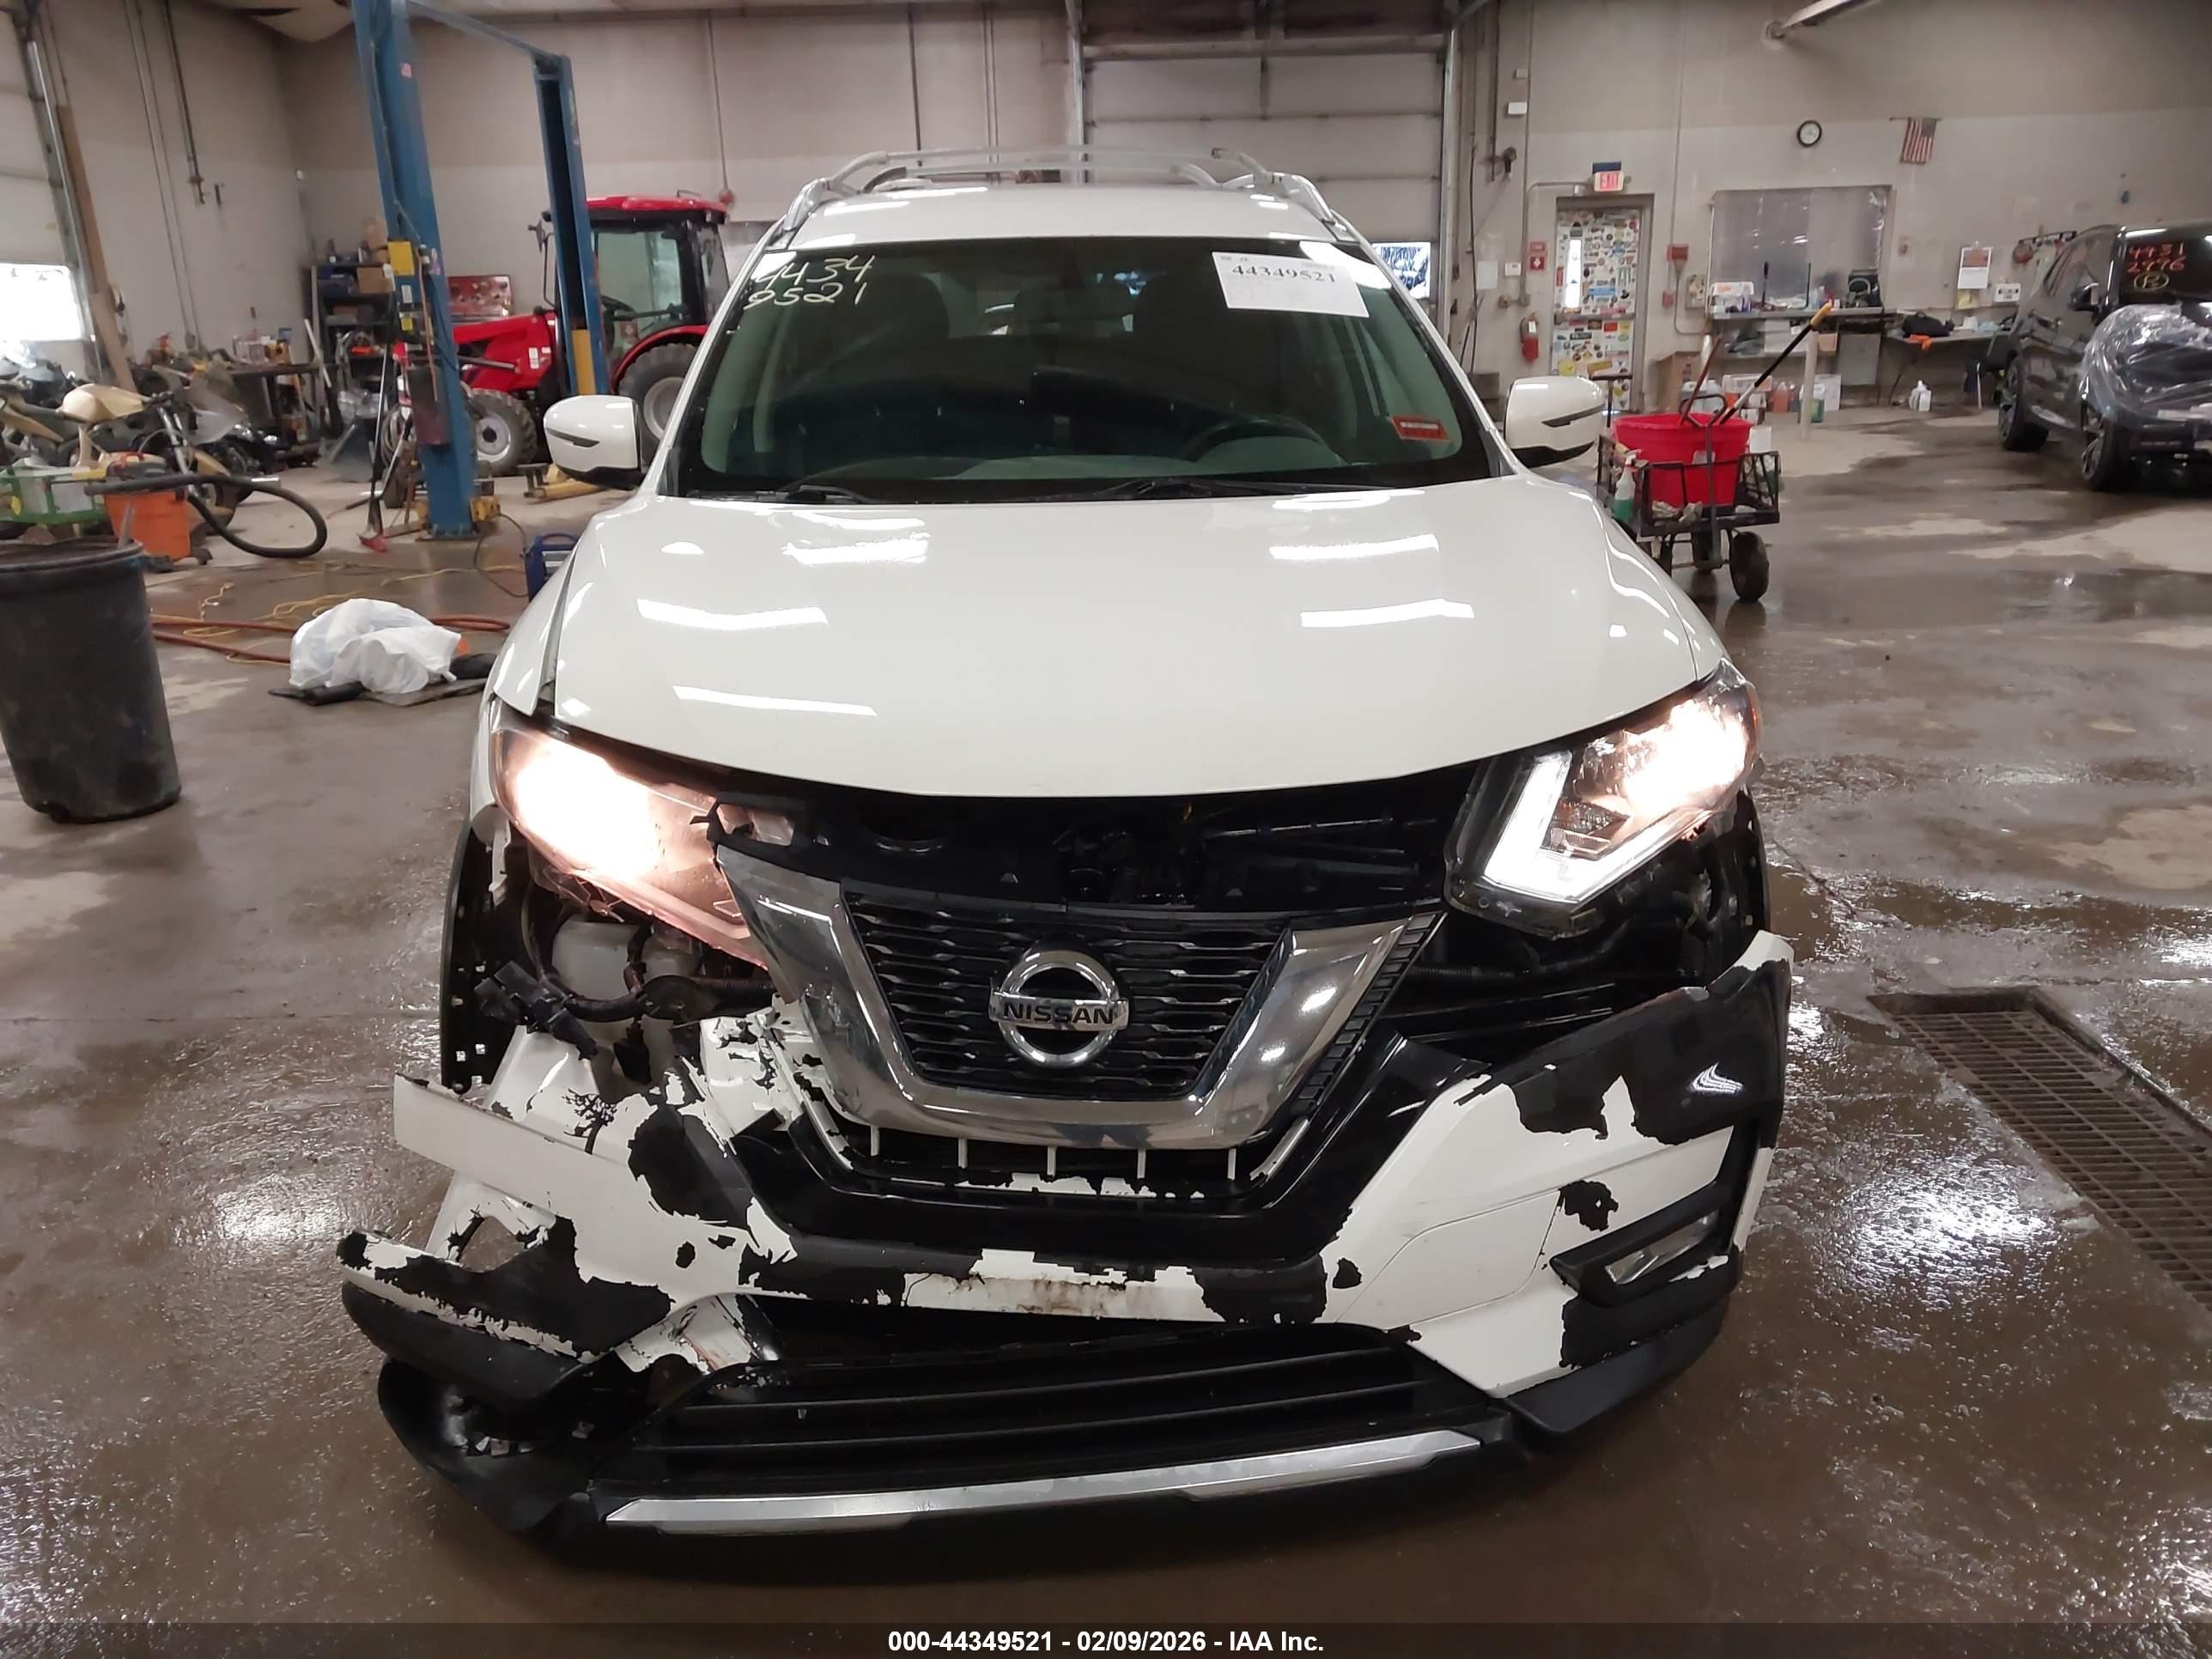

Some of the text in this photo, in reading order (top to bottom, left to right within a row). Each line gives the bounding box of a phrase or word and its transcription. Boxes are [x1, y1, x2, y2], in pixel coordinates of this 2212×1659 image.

[1232, 264, 1336, 283] 44349521
[744, 282, 868, 310] 9521
[1003, 1002, 1114, 1024] NISSAN
